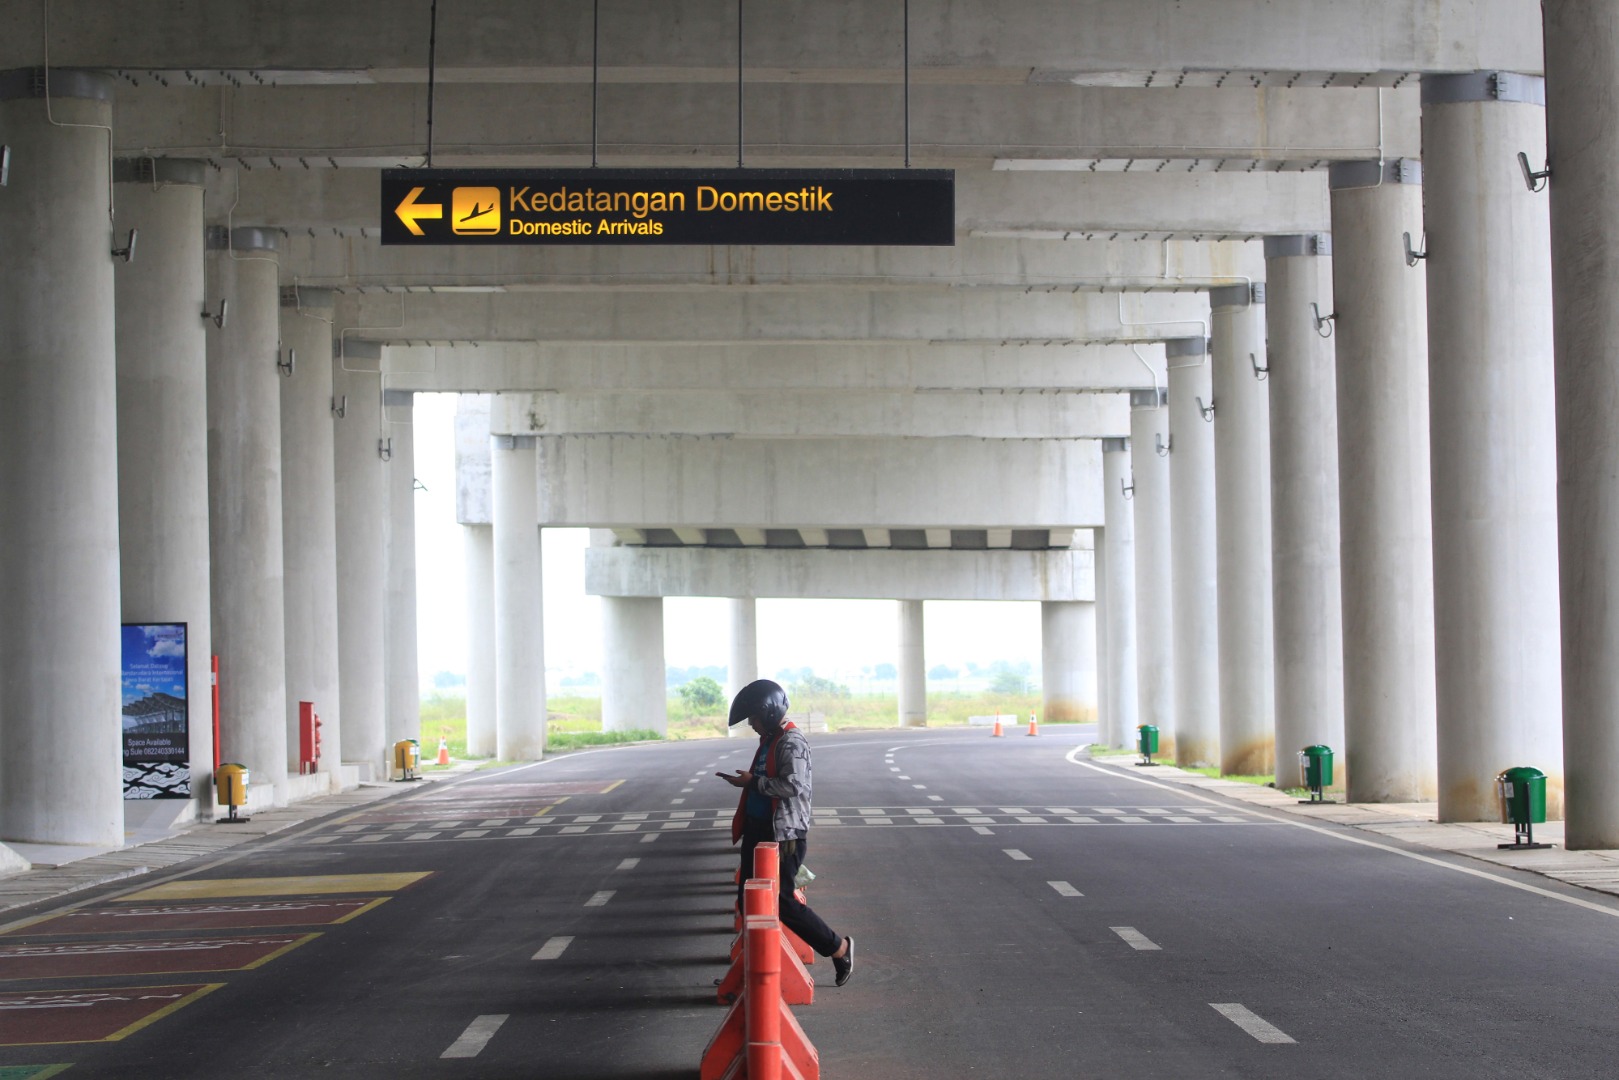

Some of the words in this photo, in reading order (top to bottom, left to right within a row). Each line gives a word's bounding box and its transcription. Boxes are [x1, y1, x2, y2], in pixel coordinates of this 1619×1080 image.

[509, 185, 686, 219] Kedatangan
[696, 185, 834, 212] Domestik
[509, 218, 592, 236] Domestic
[597, 218, 664, 236] Arrivals
[127, 738, 145, 748] Space
[146, 738, 172, 747] Available
[130, 747, 143, 756] Sule
